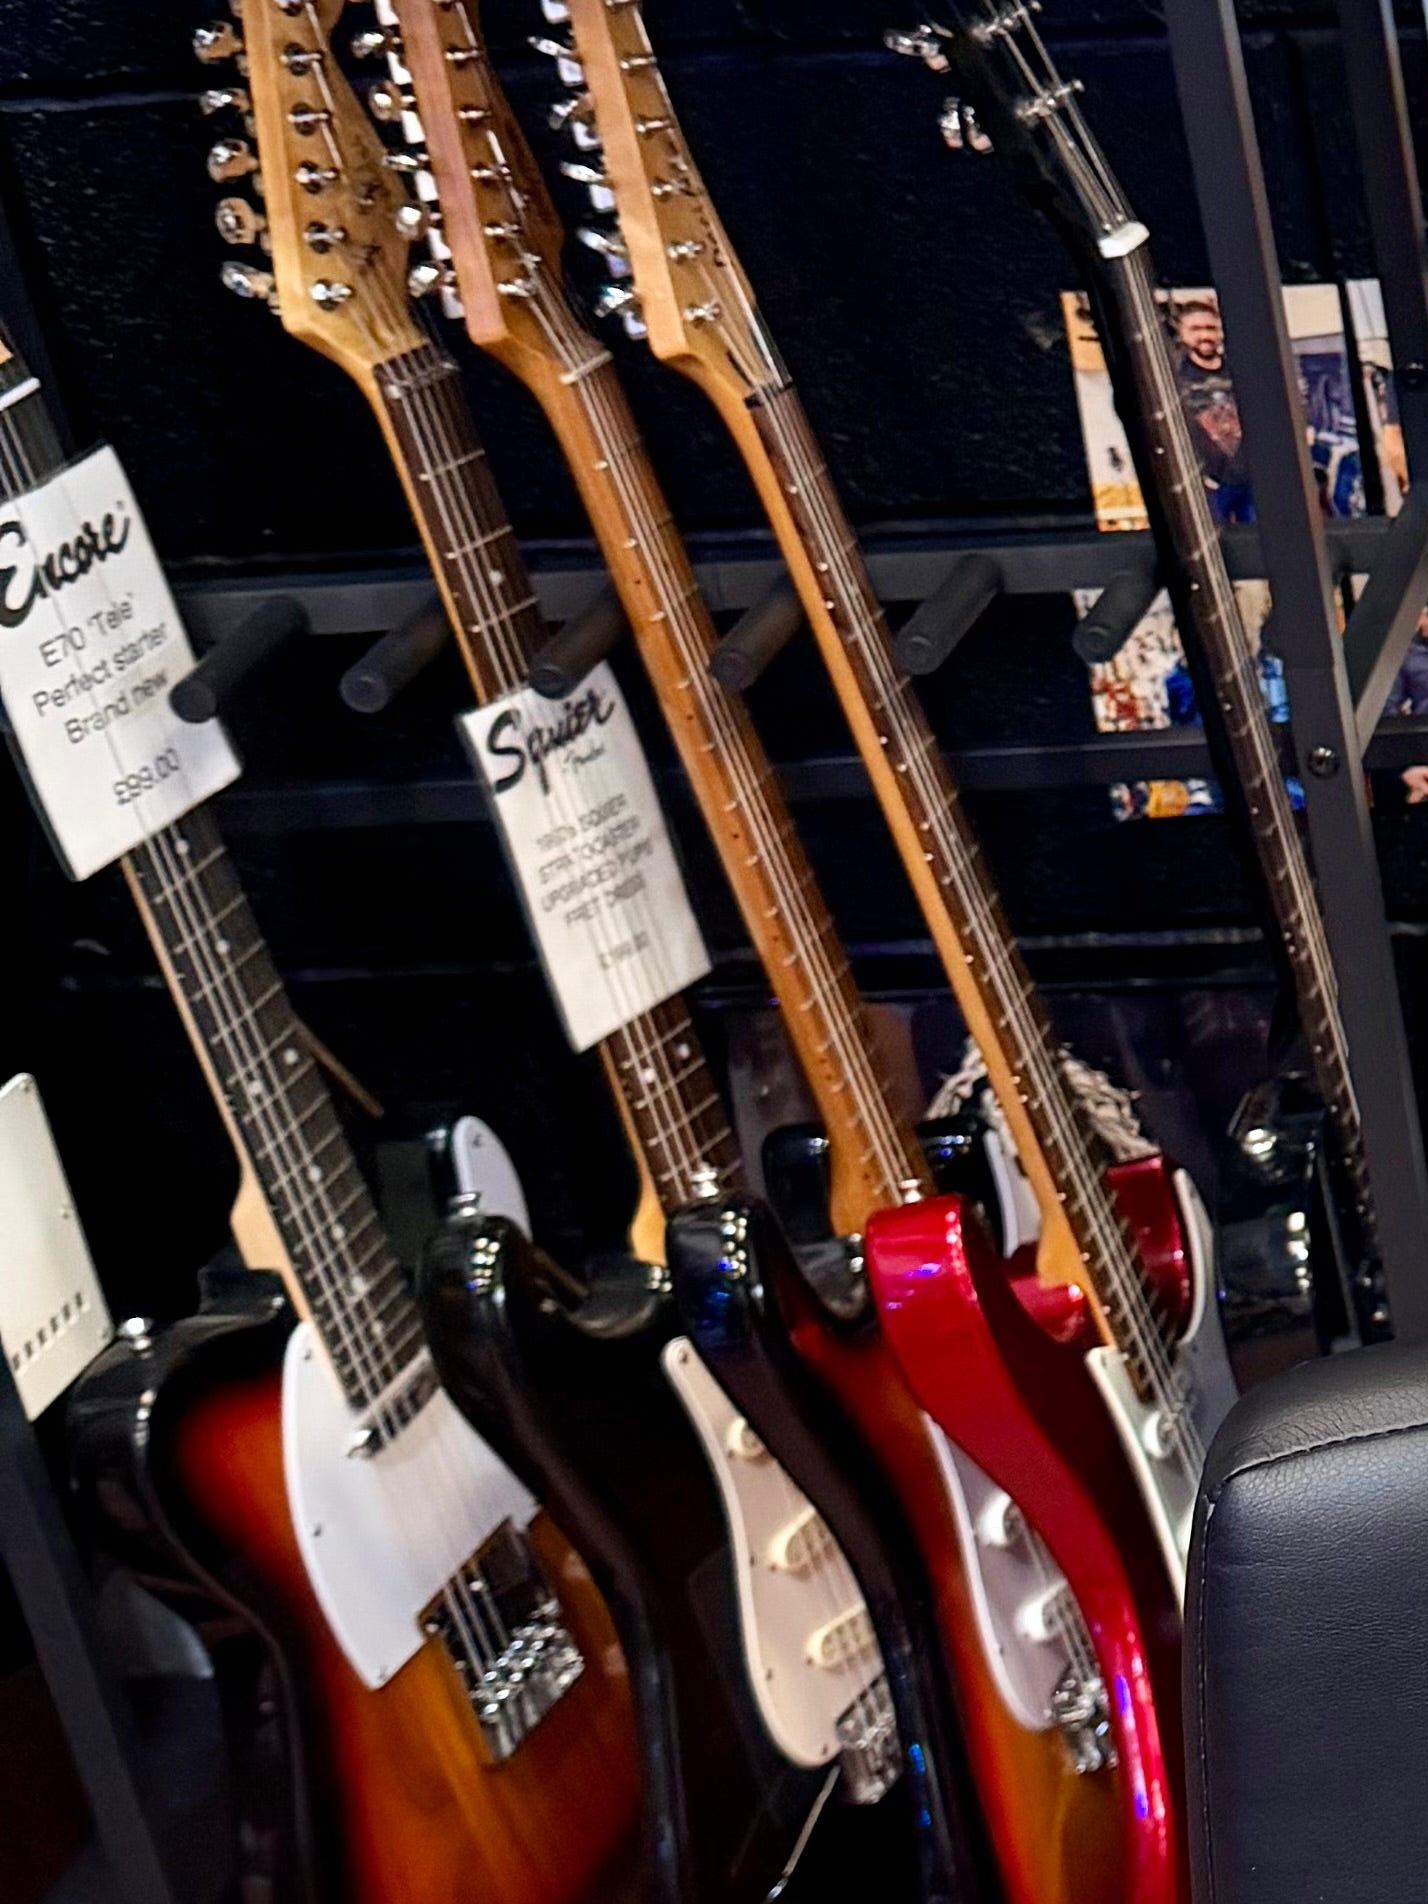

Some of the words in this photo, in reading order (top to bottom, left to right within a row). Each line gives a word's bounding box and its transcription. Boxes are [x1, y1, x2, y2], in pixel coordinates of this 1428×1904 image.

[0, 513, 131, 628] Encore
[32, 660, 112, 717] Perfect
[112, 622, 169, 672] starter
[38, 626, 86, 668] E70
[63, 696, 130, 745] Brand
[131, 668, 170, 700] new
[487, 688, 617, 795] Squier
[112, 747, 181, 807] £99.00
